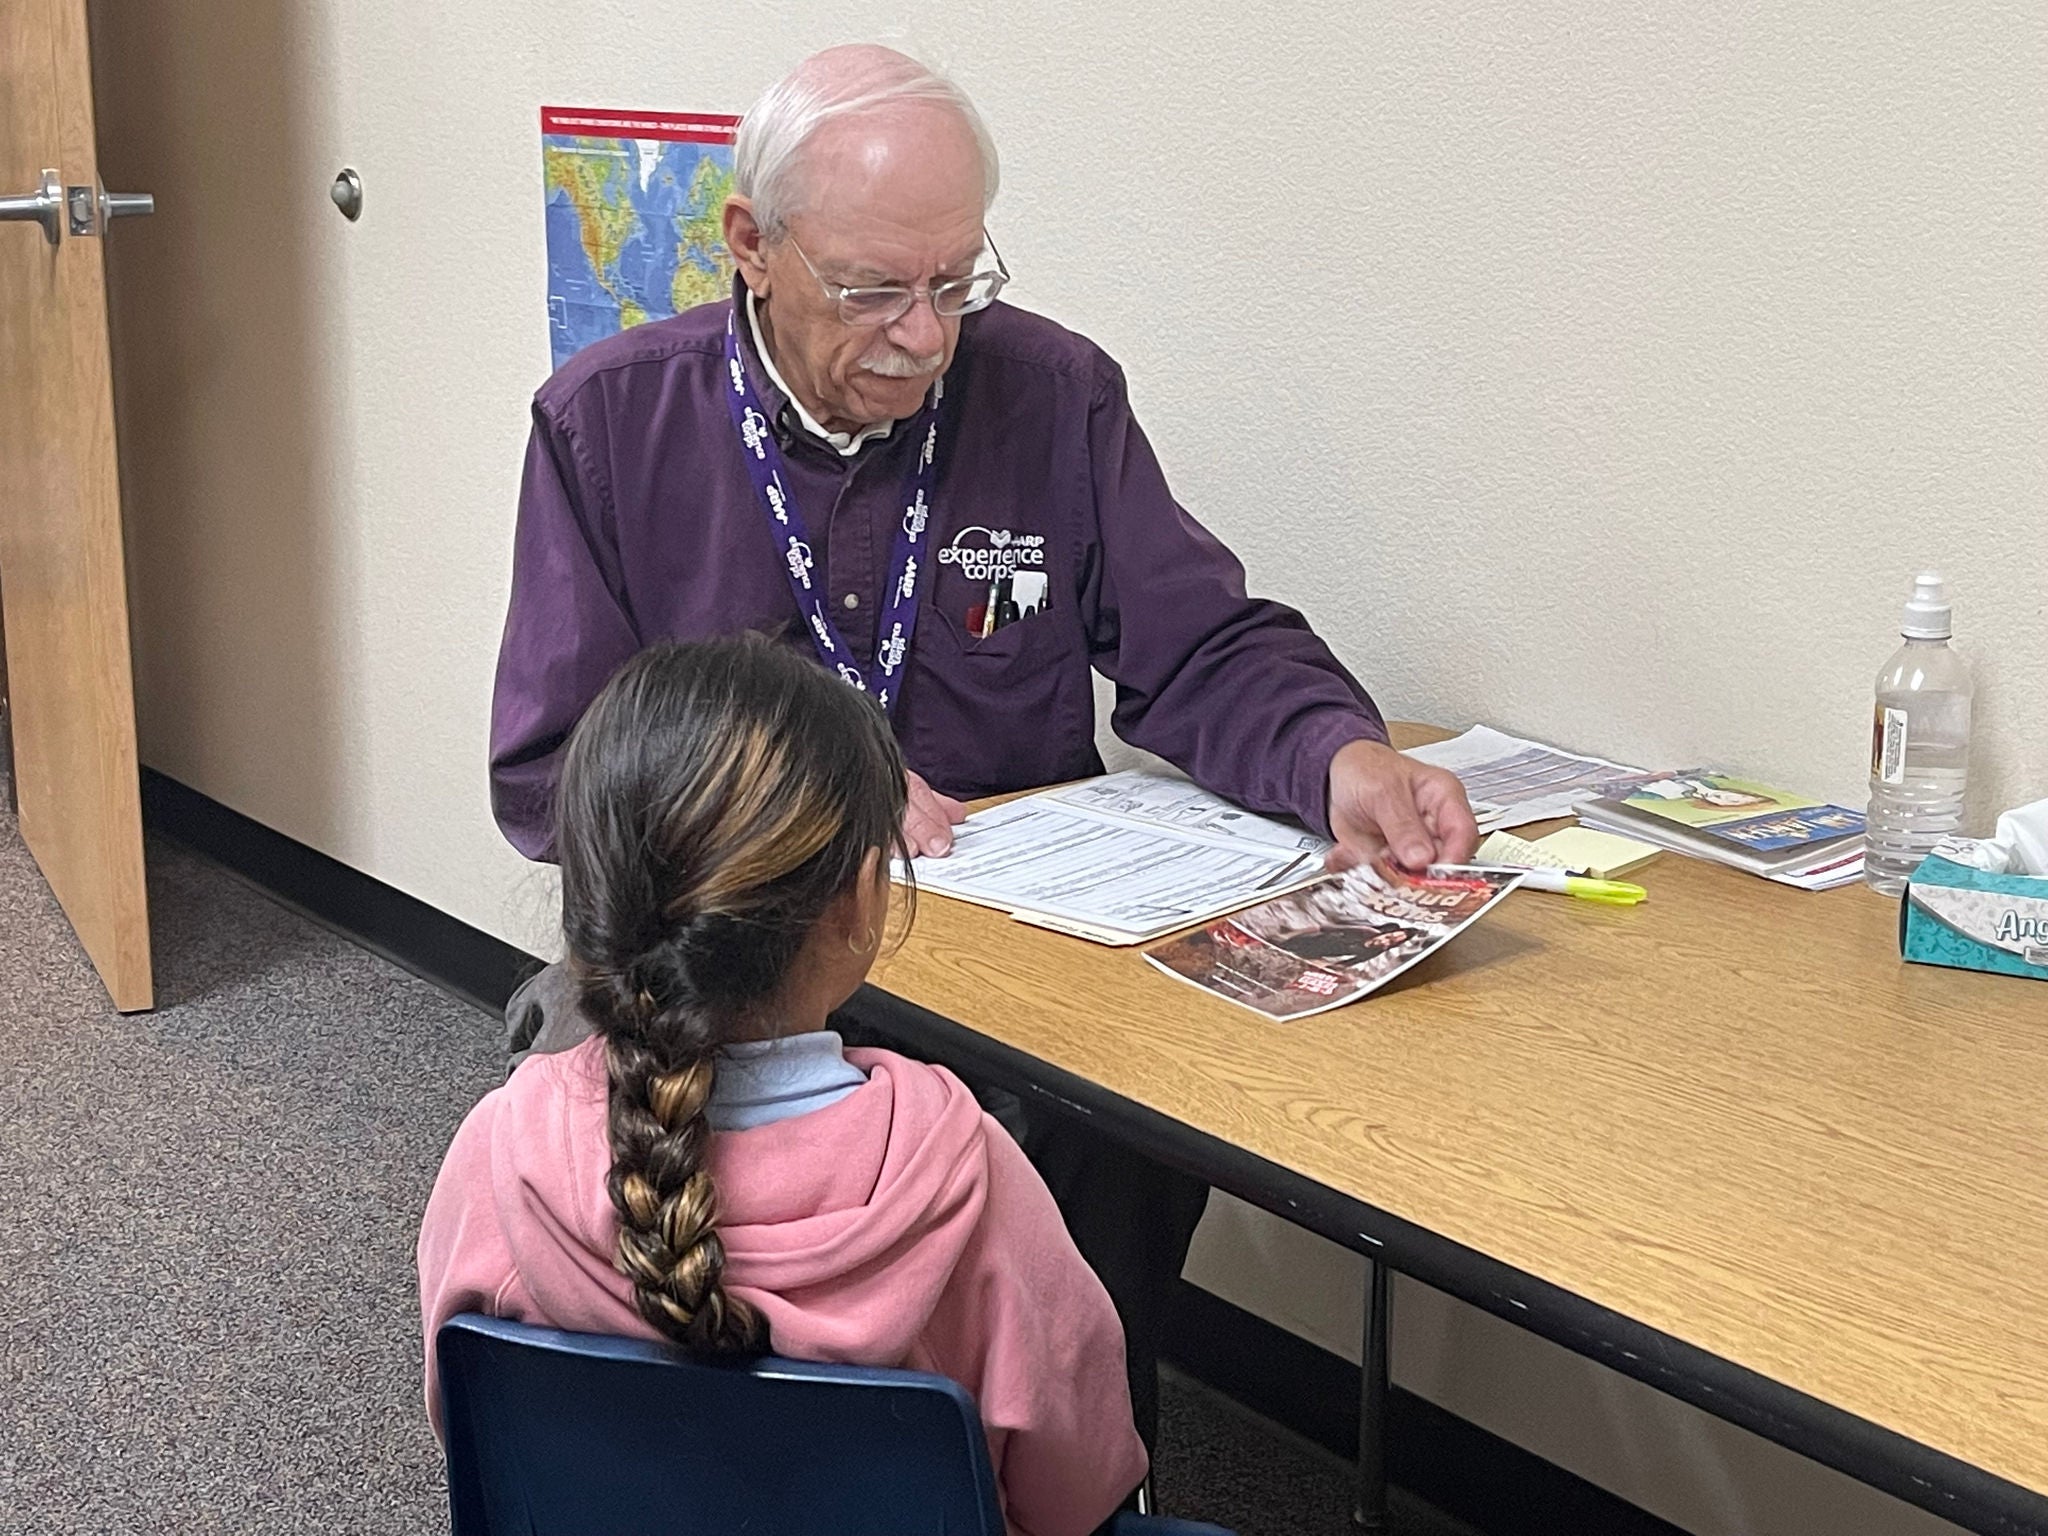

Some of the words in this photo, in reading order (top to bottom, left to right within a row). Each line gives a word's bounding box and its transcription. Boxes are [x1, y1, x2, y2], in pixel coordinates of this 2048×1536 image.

[766, 485, 787, 522] AARP
[938, 547, 1044, 570] experience
[964, 564, 1017, 585] corps
[903, 559, 917, 598] AARP
[1994, 908, 2048, 946] Ang
